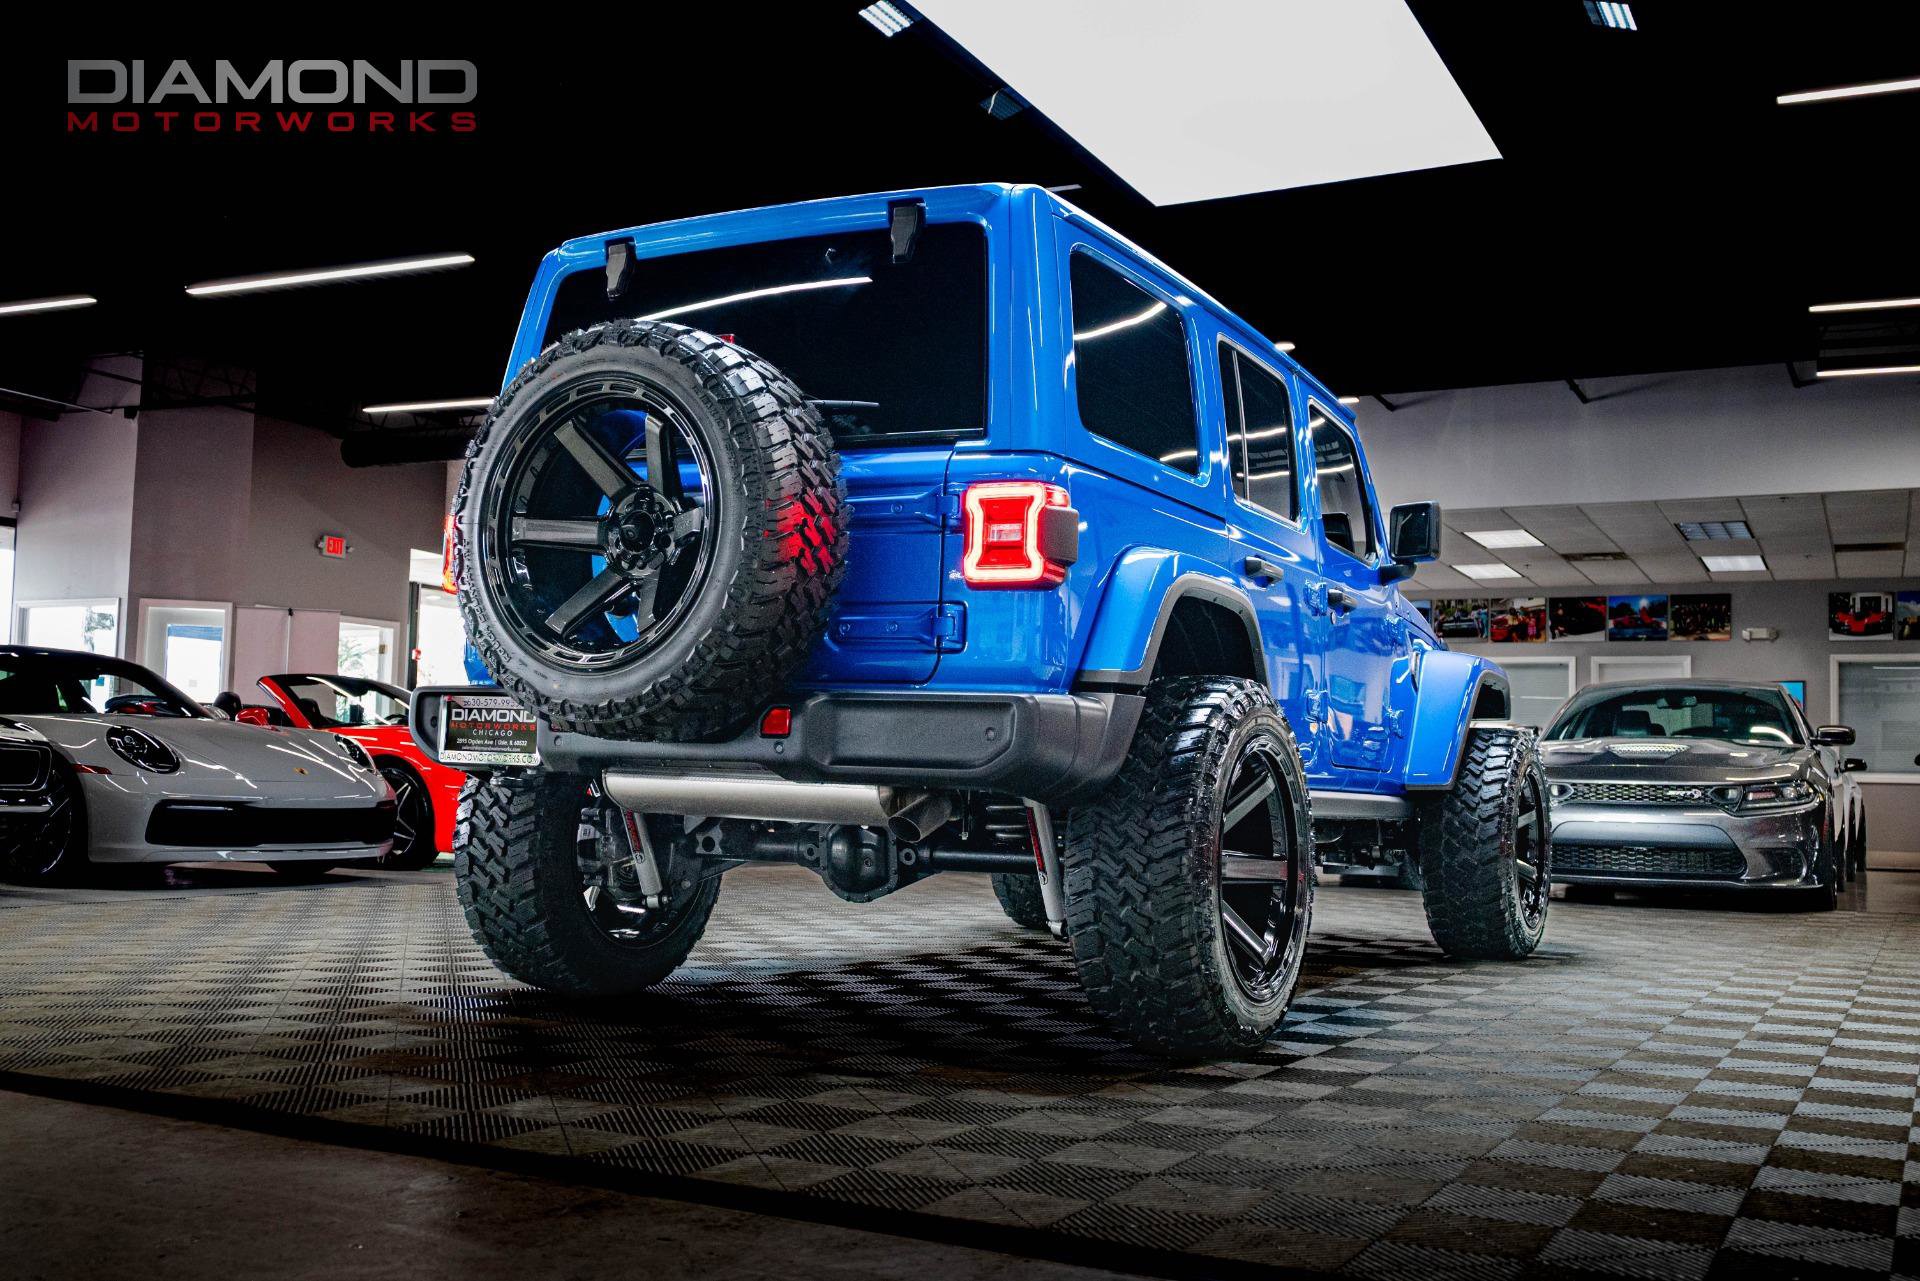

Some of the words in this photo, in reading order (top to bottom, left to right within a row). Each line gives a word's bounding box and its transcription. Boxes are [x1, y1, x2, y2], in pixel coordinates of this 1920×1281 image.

[451, 708, 536, 722] DIAMOND
[449, 721, 536, 731] MOTORWORKS
[472, 728, 513, 737] CHICAGO
